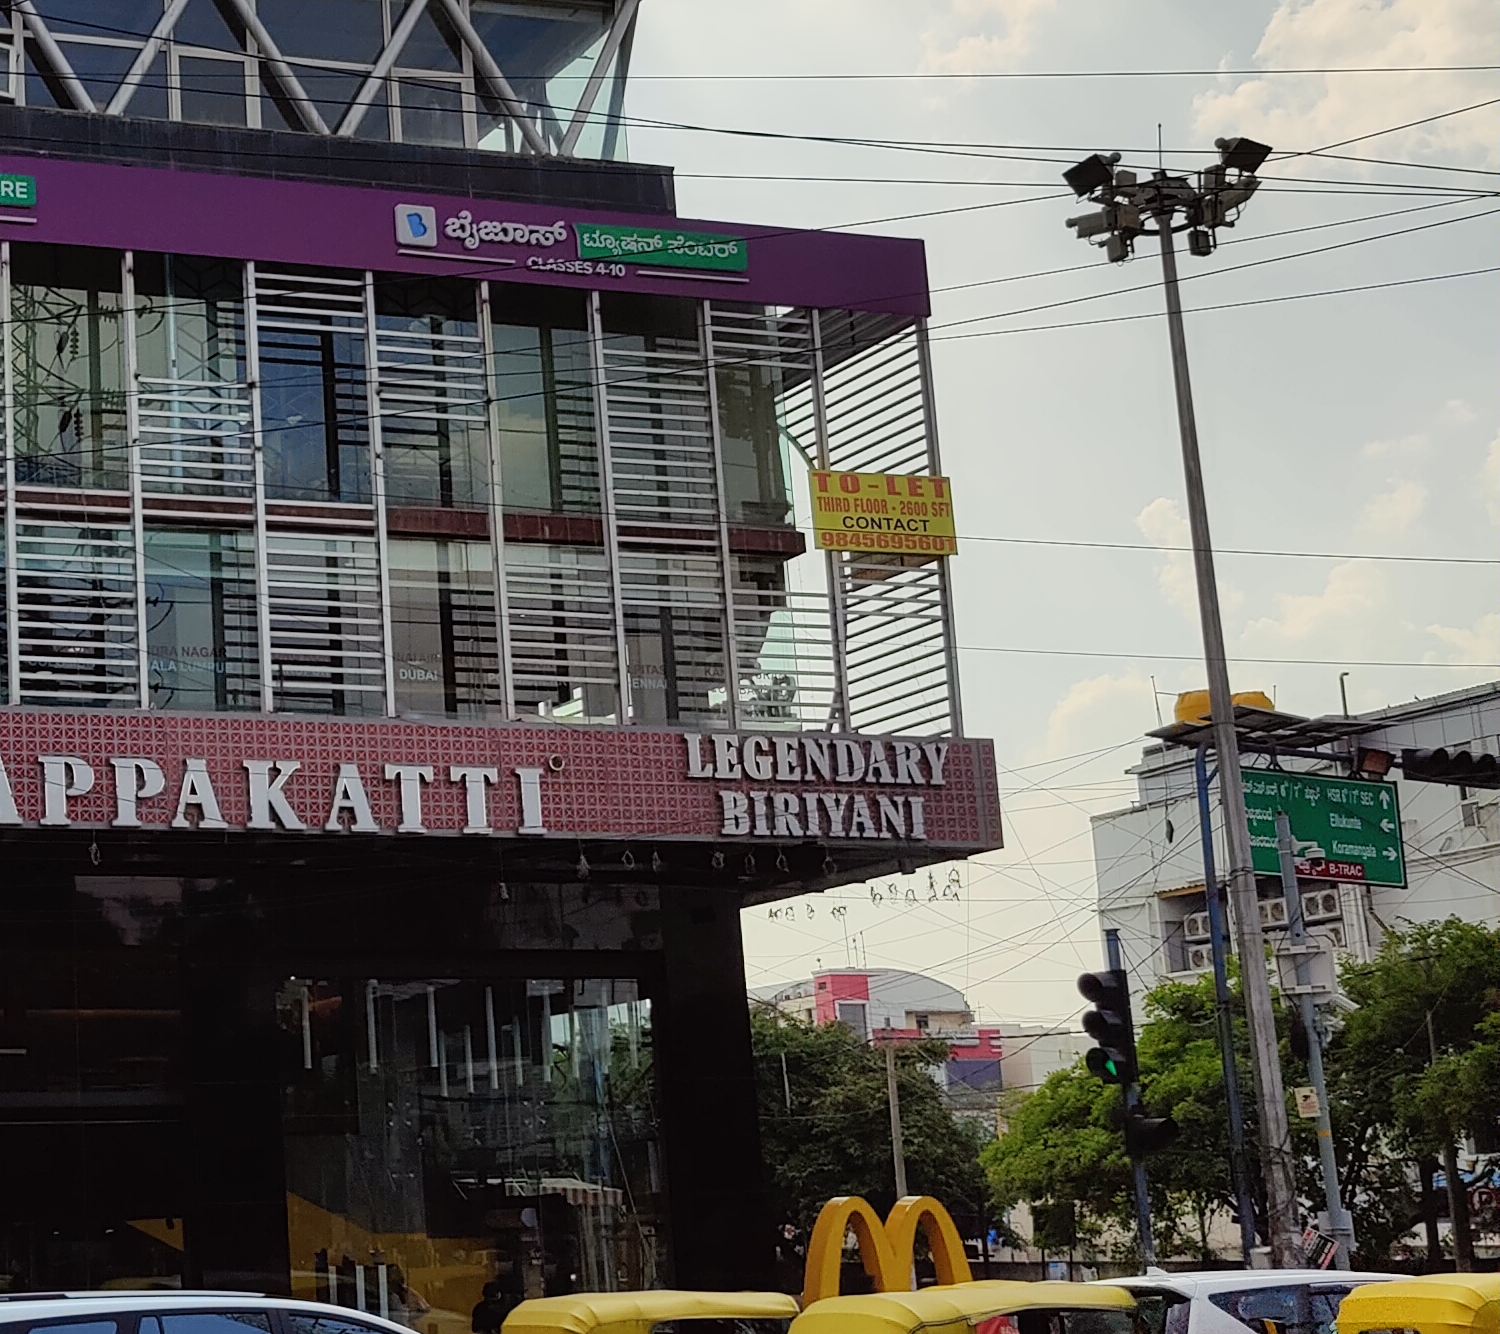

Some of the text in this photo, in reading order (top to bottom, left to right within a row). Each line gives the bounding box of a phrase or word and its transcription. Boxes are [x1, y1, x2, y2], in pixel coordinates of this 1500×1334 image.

[526, 256, 626, 278] CLASSES 4-10
[816, 496, 850, 513] THIRD
[854, 498, 889, 515] FLOOR
[900, 501, 928, 517] 2600
[931, 502, 949, 518] SFT
[842, 516, 930, 532] CONTACT
[821, 531, 955, 552] 9845695601
[400, 668, 438, 681] DUBAI
[684, 732, 949, 785] LEGENDARY
[719, 790, 927, 839] BIRIYANI
[1329, 865, 1363, 877] B-TRAC
